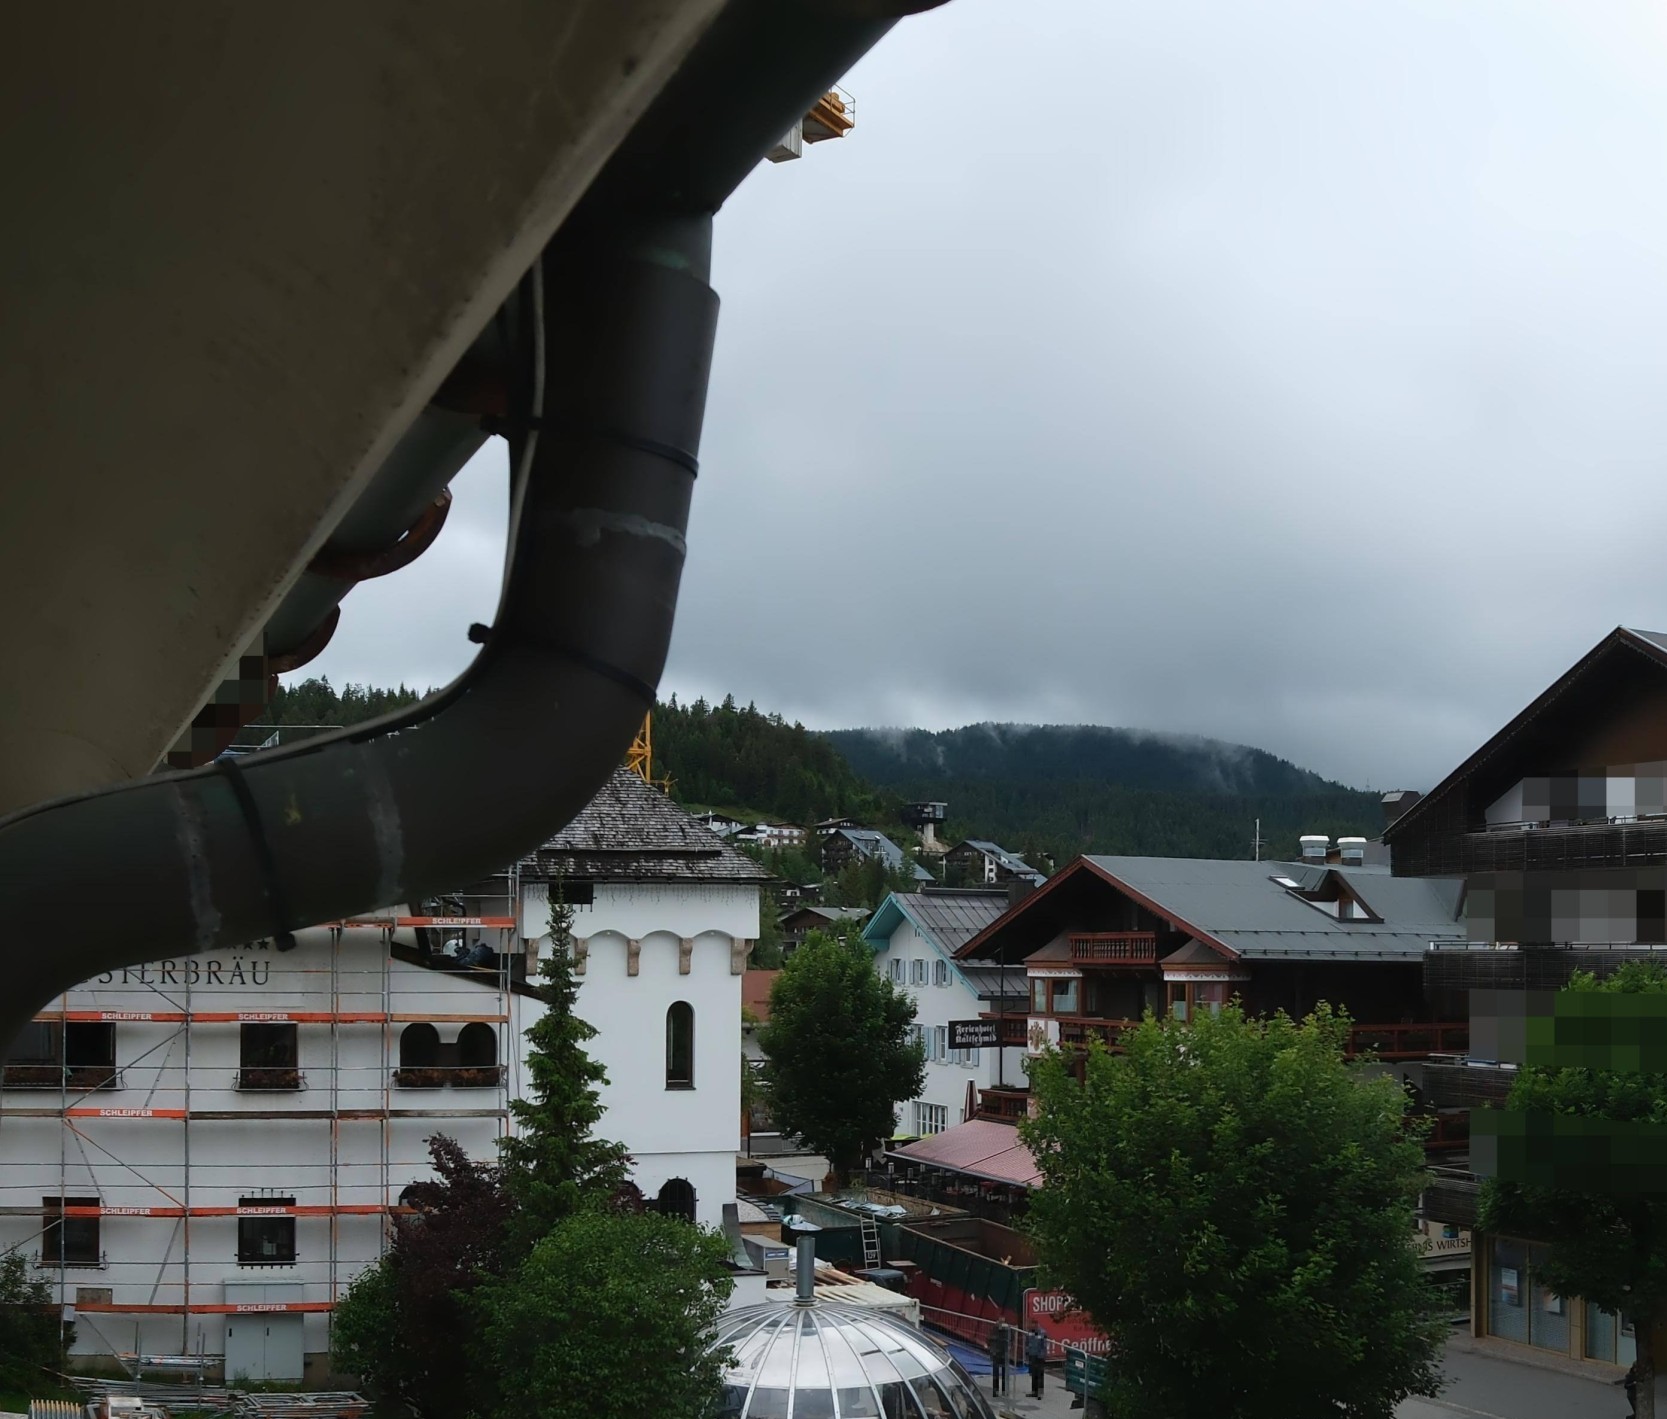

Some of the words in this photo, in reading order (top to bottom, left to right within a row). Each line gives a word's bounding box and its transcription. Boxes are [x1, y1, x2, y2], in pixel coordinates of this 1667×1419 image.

[80, 958, 271, 985] STERBRÄU
[239, 1013, 288, 1021] SCHLEIPFER
[100, 1109, 153, 1117] SCHLEIPFER
[101, 1207, 150, 1215] SCHLEIPFER
[237, 1207, 286, 1215] SCHLEIPFER
[237, 1304, 287, 1312] SCHLEIPFER
